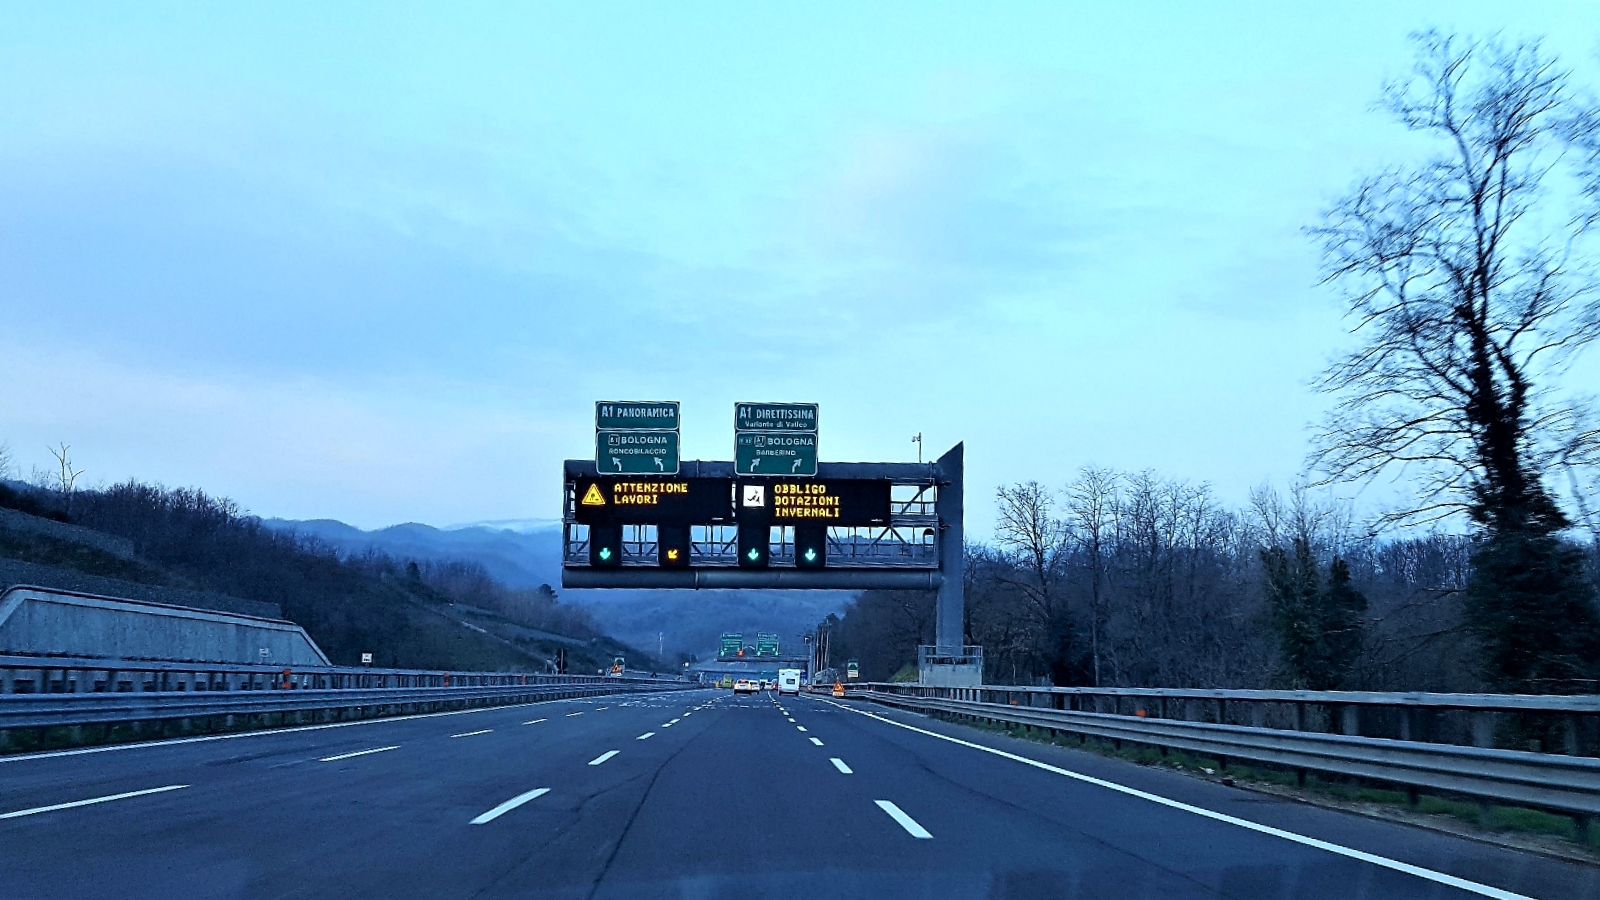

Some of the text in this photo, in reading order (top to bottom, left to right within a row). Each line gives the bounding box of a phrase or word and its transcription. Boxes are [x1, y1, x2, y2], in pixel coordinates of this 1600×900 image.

[602, 405, 675, 418] A1 PANORAMICA
[740, 407, 814, 419] A1 DIRETTISSIMA
[621, 436, 668, 444] BOLOGNA
[767, 438, 814, 446] BOLOGNA
[614, 483, 688, 493] ATTENZIONE
[774, 484, 826, 494] OBBLIGO
[614, 494, 658, 504] LAVORI
[774, 496, 840, 506] DOTAZIONI
[774, 507, 840, 517] INVERNALI
